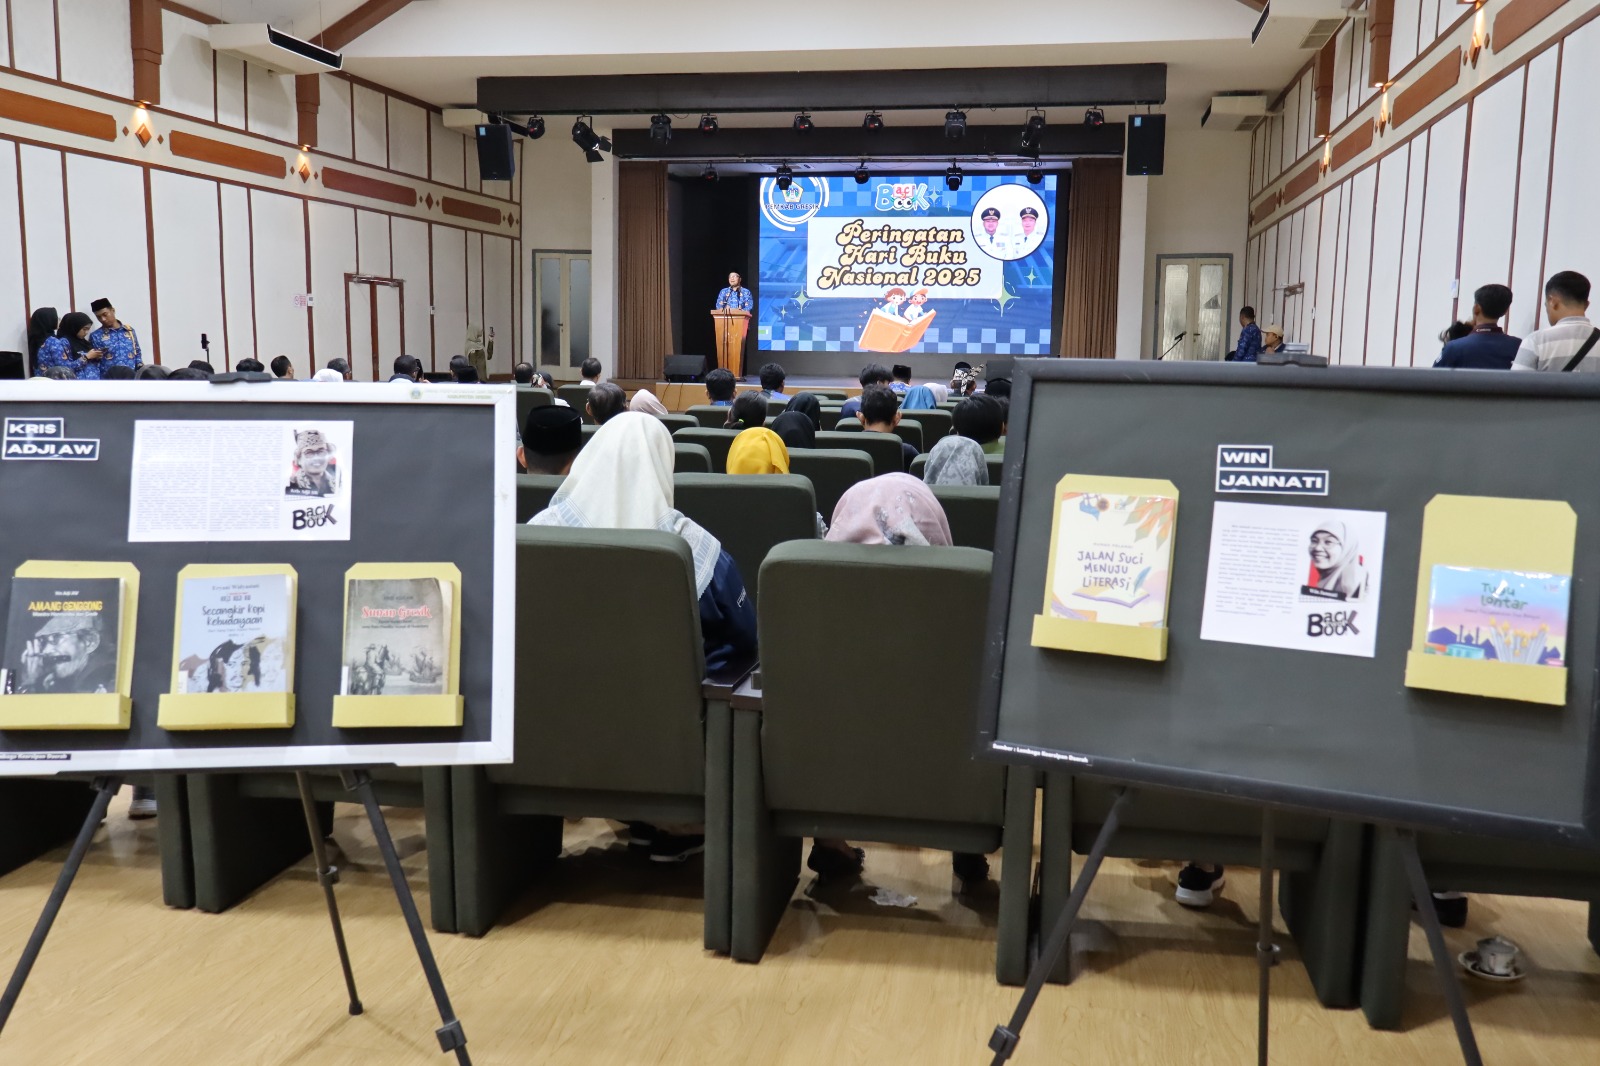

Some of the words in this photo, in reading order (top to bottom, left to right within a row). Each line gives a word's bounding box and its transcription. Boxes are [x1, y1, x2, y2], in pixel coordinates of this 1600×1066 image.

[836, 219, 965, 247] Peringatan
[838, 243, 897, 266] Hari
[901, 242, 967, 267] Buku
[817, 265, 919, 290] Nasional
[922, 267, 981, 286] 2025
[9, 423, 57, 434] KRIS
[7, 444, 56, 454] ADJI
[58, 444, 94, 454] AW
[1222, 452, 1267, 464] WIN
[1220, 475, 1322, 489] JANNATI
[1077, 551, 1115, 562] JALAN
[1084, 563, 1129, 574] MENUJU
[28, 601, 62, 611] AMANG
[62, 601, 103, 611] GENGGONG
[202, 604, 246, 618] Secangkir
[361, 605, 397, 619] Sunan
[397, 604, 433, 620] Gresik
